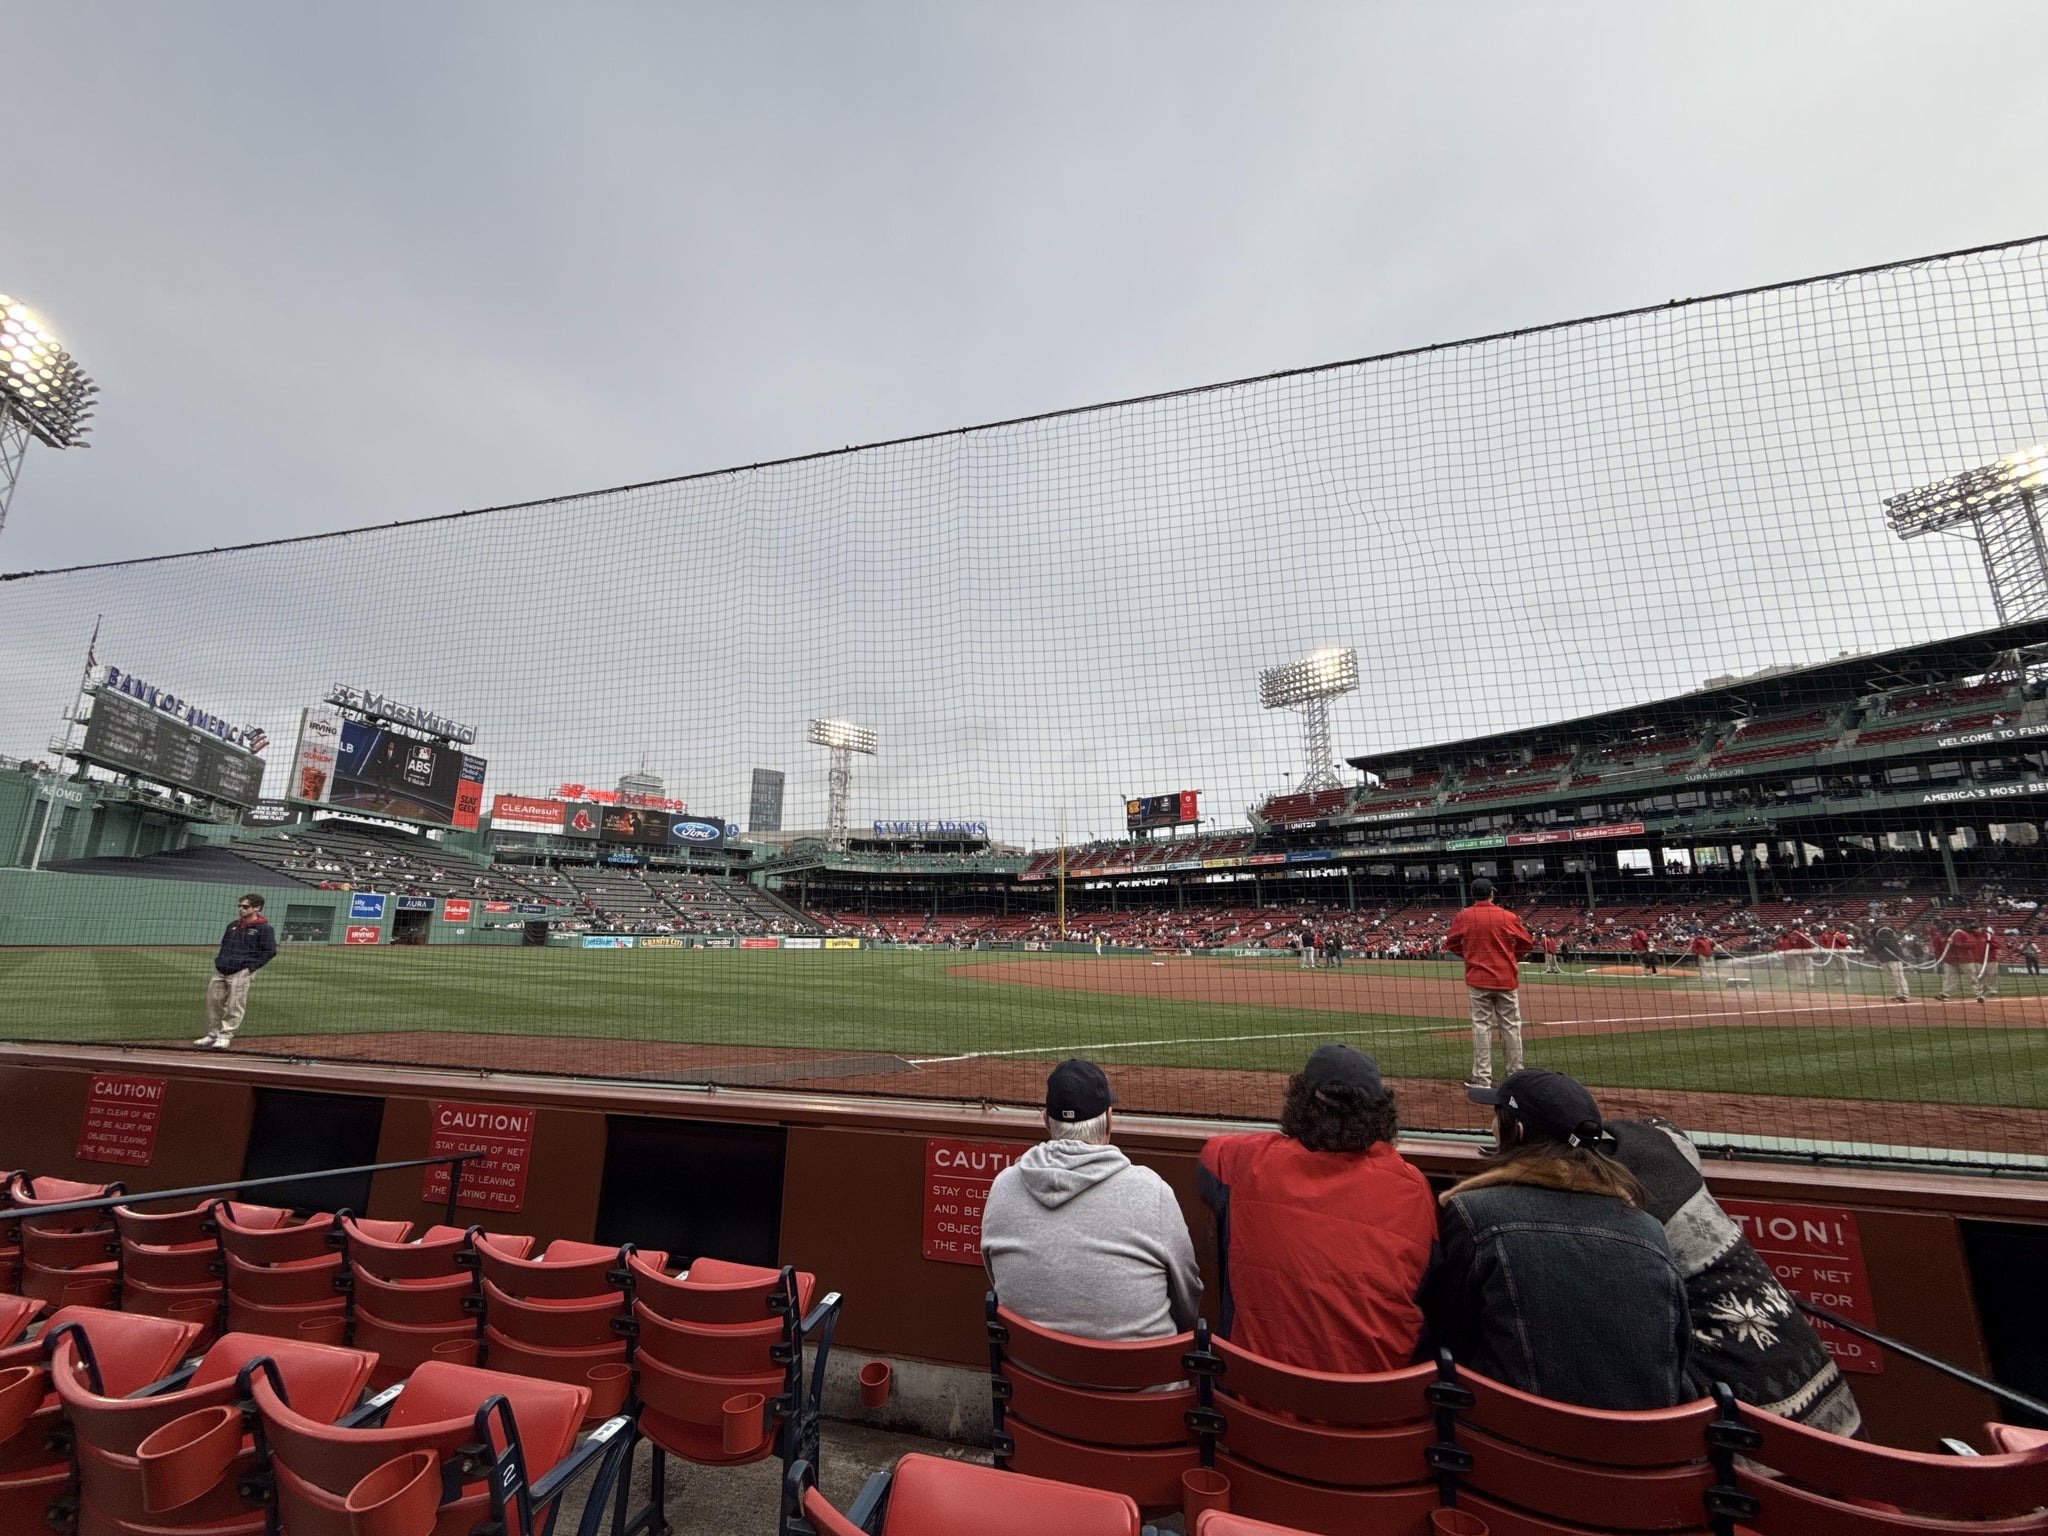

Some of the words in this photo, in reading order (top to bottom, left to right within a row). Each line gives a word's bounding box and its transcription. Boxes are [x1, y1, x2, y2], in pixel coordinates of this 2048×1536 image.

[108, 666, 161, 709] BANK
[163, 694, 183, 715] OF
[186, 706, 245, 747] AMERICA
[308, 721, 338, 736] IRVING
[1938, 733, 1994, 747] WELCOME
[1999, 730, 2015, 738] TO
[408, 759, 431, 774] ABS
[1709, 769, 1744, 779] PAVILION
[1923, 789, 1985, 802] AMERICA'S
[1991, 785, 2024, 796] MOST
[501, 803, 560, 816] CLEAResult
[681, 825, 710, 839] Ford
[938, 821, 988, 835] ADAMS
[1291, 821, 1316, 829] UNITED
[95, 1082, 161, 1099] CAUTION!
[107, 1108, 128, 1116] CLEAR
[88, 1120, 100, 1128] AND
[441, 1111, 528, 1132] CAUTION!
[87, 1132, 117, 1142] OBJECTS
[120, 1136, 147, 1145] LEAVING
[83, 1145, 96, 1153] THE
[98, 1147, 124, 1156] PLAYING
[127, 1150, 147, 1158] FIELD
[435, 1141, 455, 1150] STAY
[458, 1143, 487, 1152] CLEAR
[491, 1146, 503, 1154] OF
[507, 1148, 524, 1156] NET
[470, 1160, 498, 1169] ALERT
[502, 1163, 520, 1172] FOR
[935, 1149, 1011, 1171] CAUTI
[435, 1171, 474, 1183] OBCTS
[479, 1176, 515, 1187] LEAVING
[430, 1185, 447, 1195] THE
[457, 1190, 486, 1199] LAYING
[490, 1192, 516, 1203] FIELD
[933, 1185, 960, 1196] STAY
[966, 1188, 989, 1199] CLE
[934, 1205, 958, 1215] AND
[964, 1207, 981, 1217] BE
[938, 1222, 980, 1235] OBJEC
[1729, 1214, 1844, 1246] TION!
[933, 1240, 957, 1251] THE
[1776, 1265, 1803, 1278] OF
[1814, 1269, 1853, 1283] NET
[1811, 1292, 1854, 1307] FOR
[1824, 1341, 1862, 1357] ELD
[503, 1463, 517, 1487] 2
